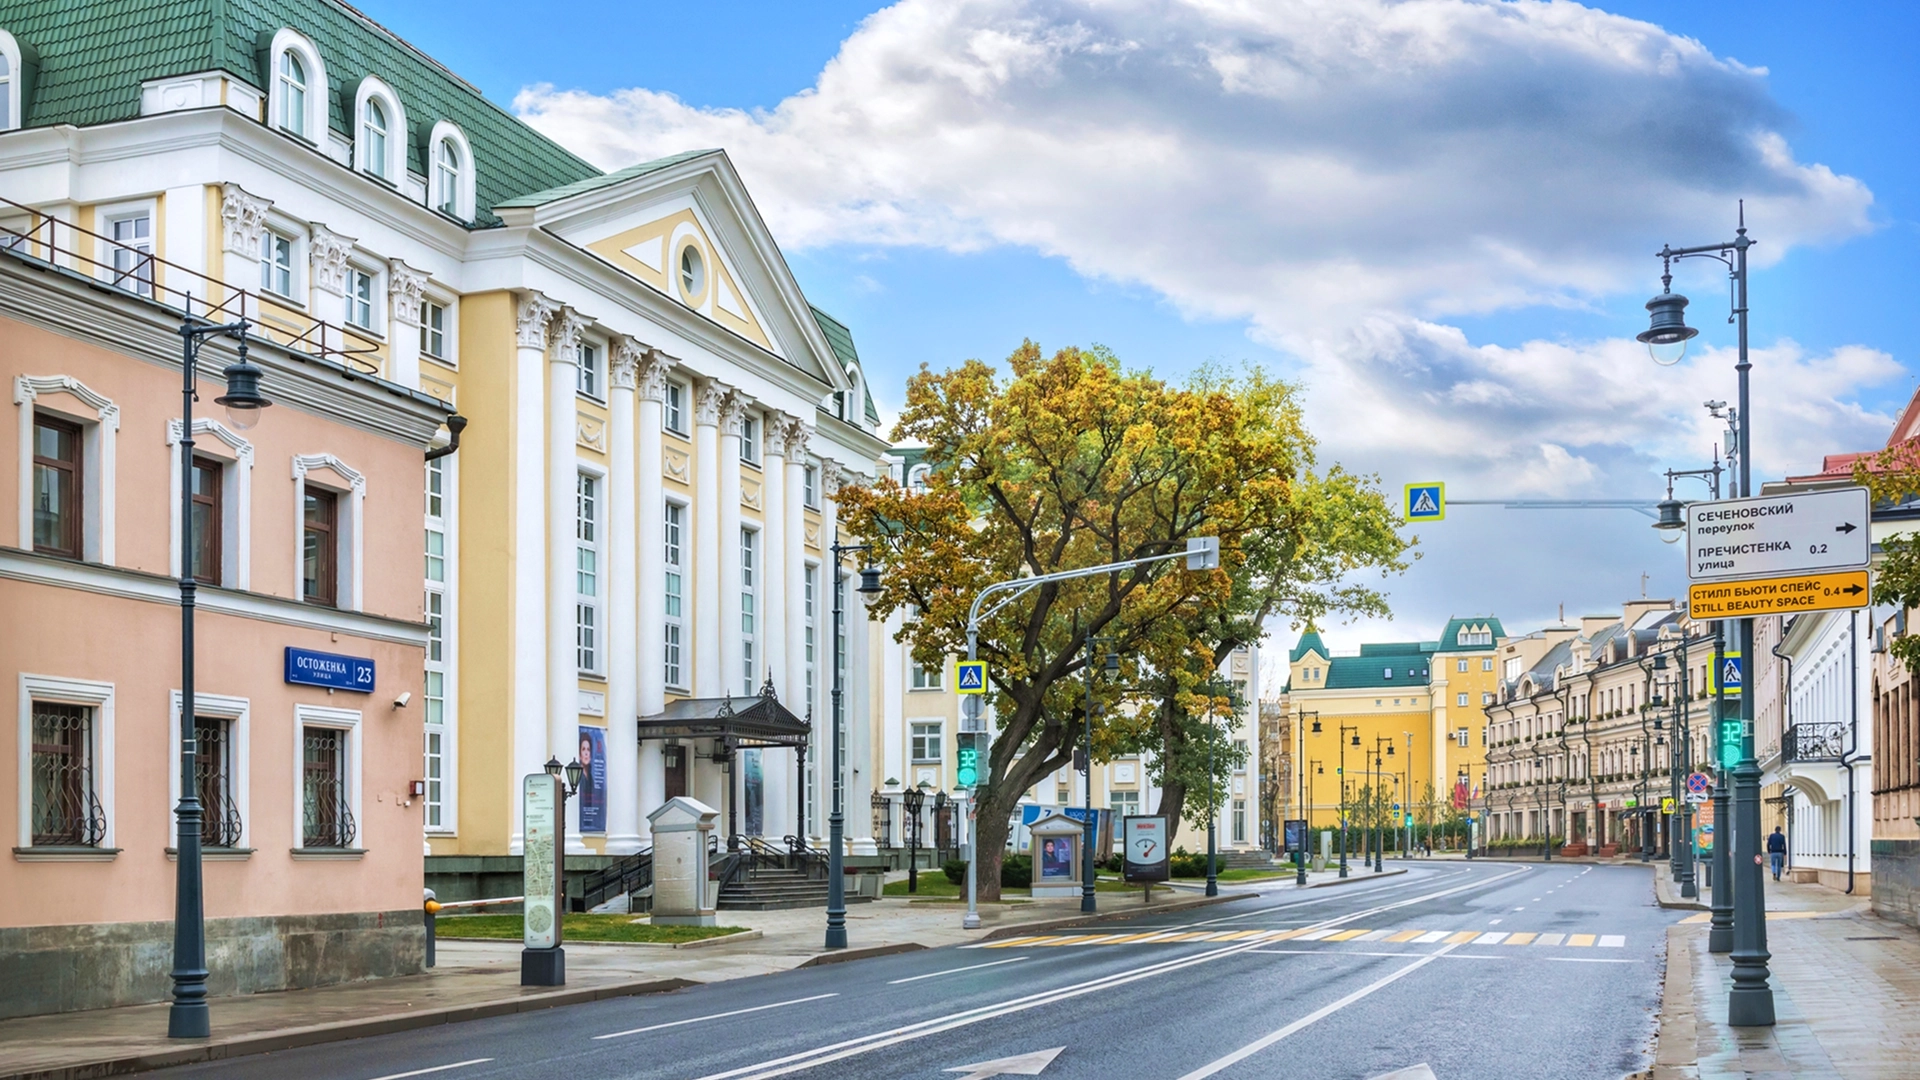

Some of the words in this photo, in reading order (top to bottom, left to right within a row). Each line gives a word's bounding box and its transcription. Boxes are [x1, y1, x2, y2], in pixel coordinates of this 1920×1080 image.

[1697, 503, 1793, 522] СЕЧЕНОВСКИЙ
[1697, 521, 1755, 535] переулок
[1698, 540, 1791, 557] ПРЕЧИСТЕНКА
[1809, 544, 1828, 555] 0.2
[1697, 560, 1735, 573] улица
[1693, 587, 1731, 600] СТИЛЛ
[1734, 584, 1777, 597] БЬЮТИ
[1780, 581, 1821, 594] СПЕЙС
[1823, 586, 1840, 597] 0.4
[1693, 603, 1724, 613] STILL
[1727, 599, 1774, 611] BEAUTY
[1777, 595, 1815, 607] SPACE
[297, 656, 347, 674] ОСТОЖЕНКА
[357, 666, 372, 683] 23
[1723, 722, 1741, 742] 32
[961, 750, 976, 767] 32
